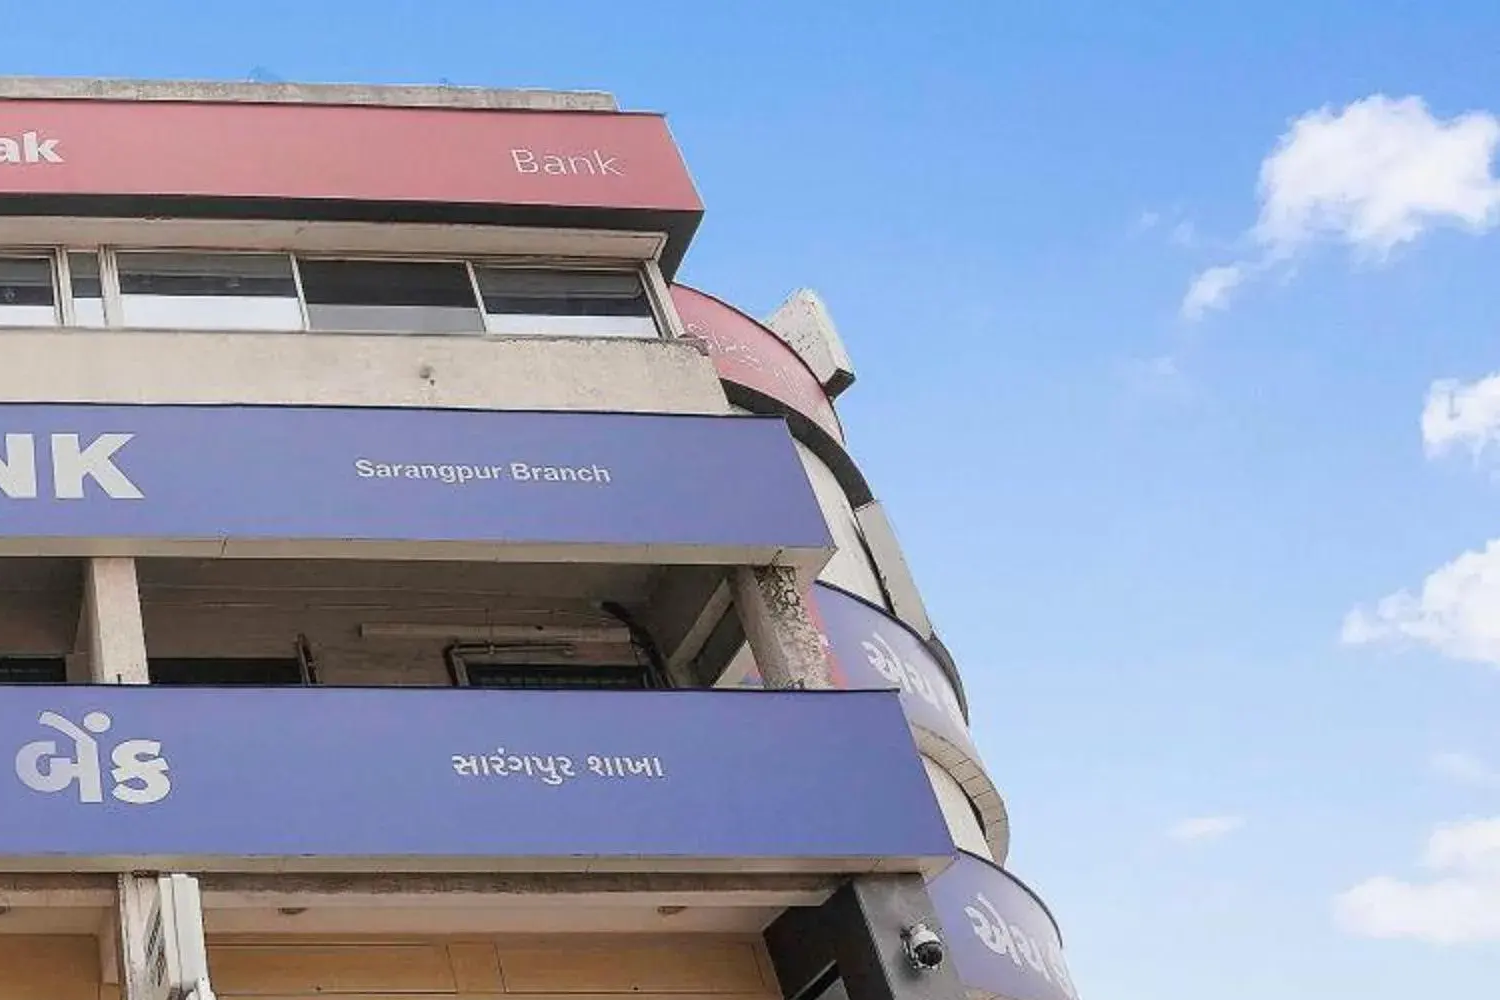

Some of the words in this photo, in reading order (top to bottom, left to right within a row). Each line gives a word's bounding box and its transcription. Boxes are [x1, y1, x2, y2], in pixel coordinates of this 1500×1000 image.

[509, 147, 625, 178] Bank
[355, 458, 501, 484] Sarangpur
[510, 462, 612, 484] Branch
[14, 710, 172, 804] બેંક
[450, 747, 576, 785] સારંગપુર
[587, 754, 664, 778] શાખા
